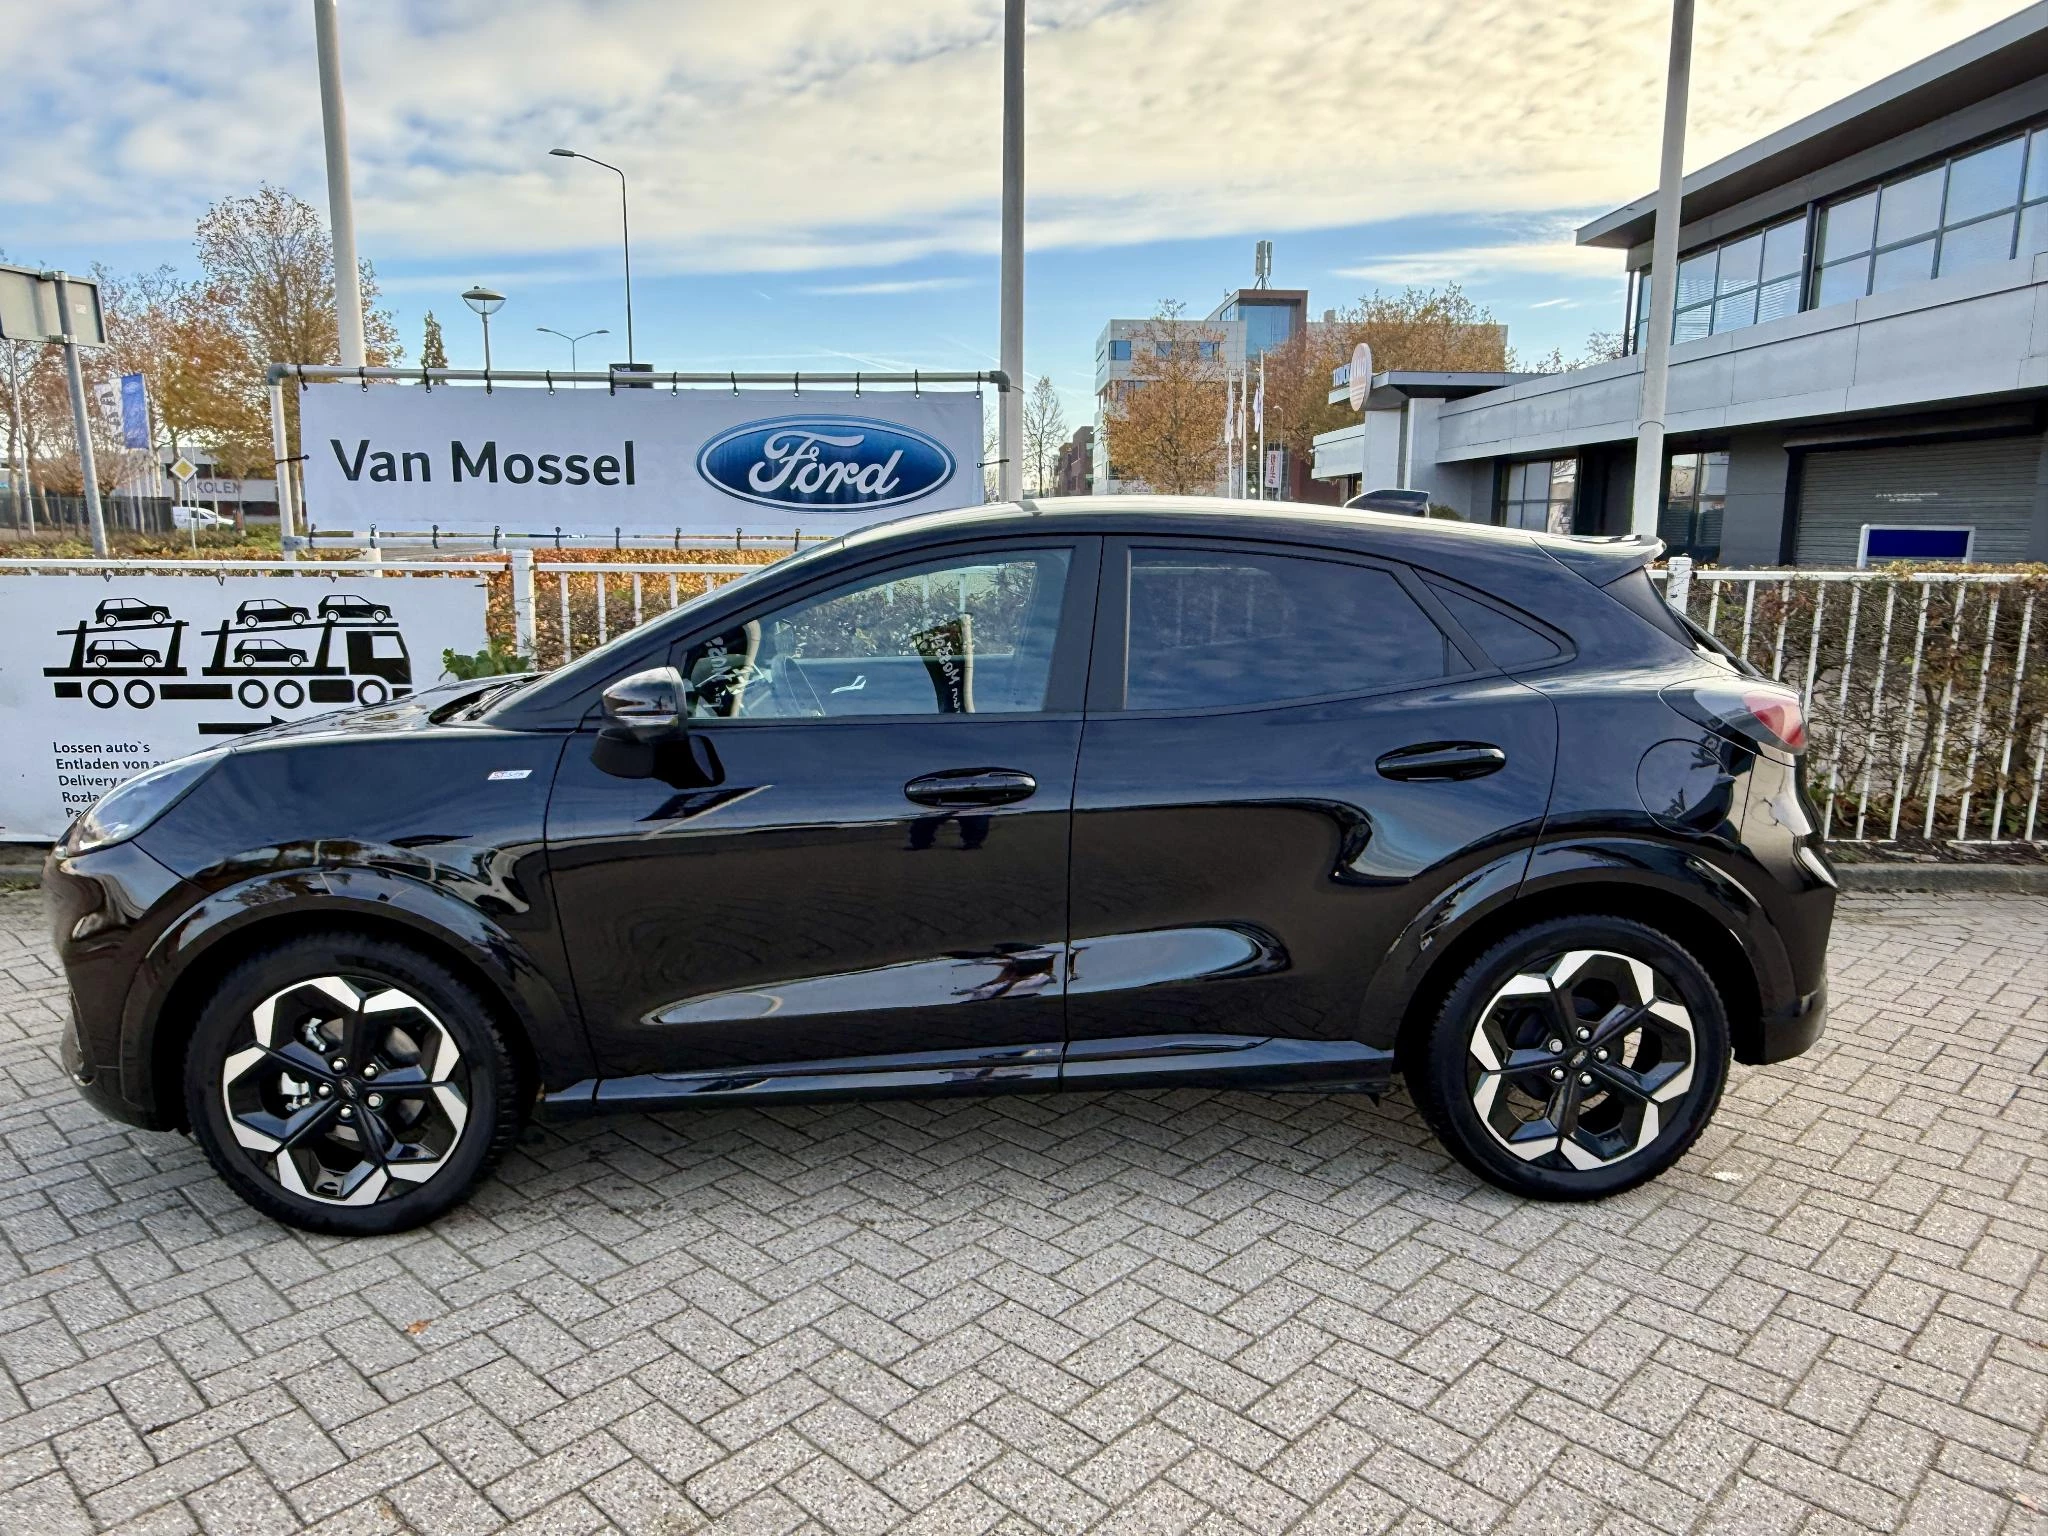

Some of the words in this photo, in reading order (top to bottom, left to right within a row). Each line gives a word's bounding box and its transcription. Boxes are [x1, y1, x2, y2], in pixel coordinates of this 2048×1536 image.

[330, 439, 432, 482] Van
[451, 440, 636, 486] Mossel
[748, 430, 904, 494] Ford
[53, 741, 102, 753] Lossen
[56, 758, 120, 770] Entladen
[122, 761, 150, 770] von
[58, 774, 118, 789] Delivery
[62, 791, 100, 803] Rozła
